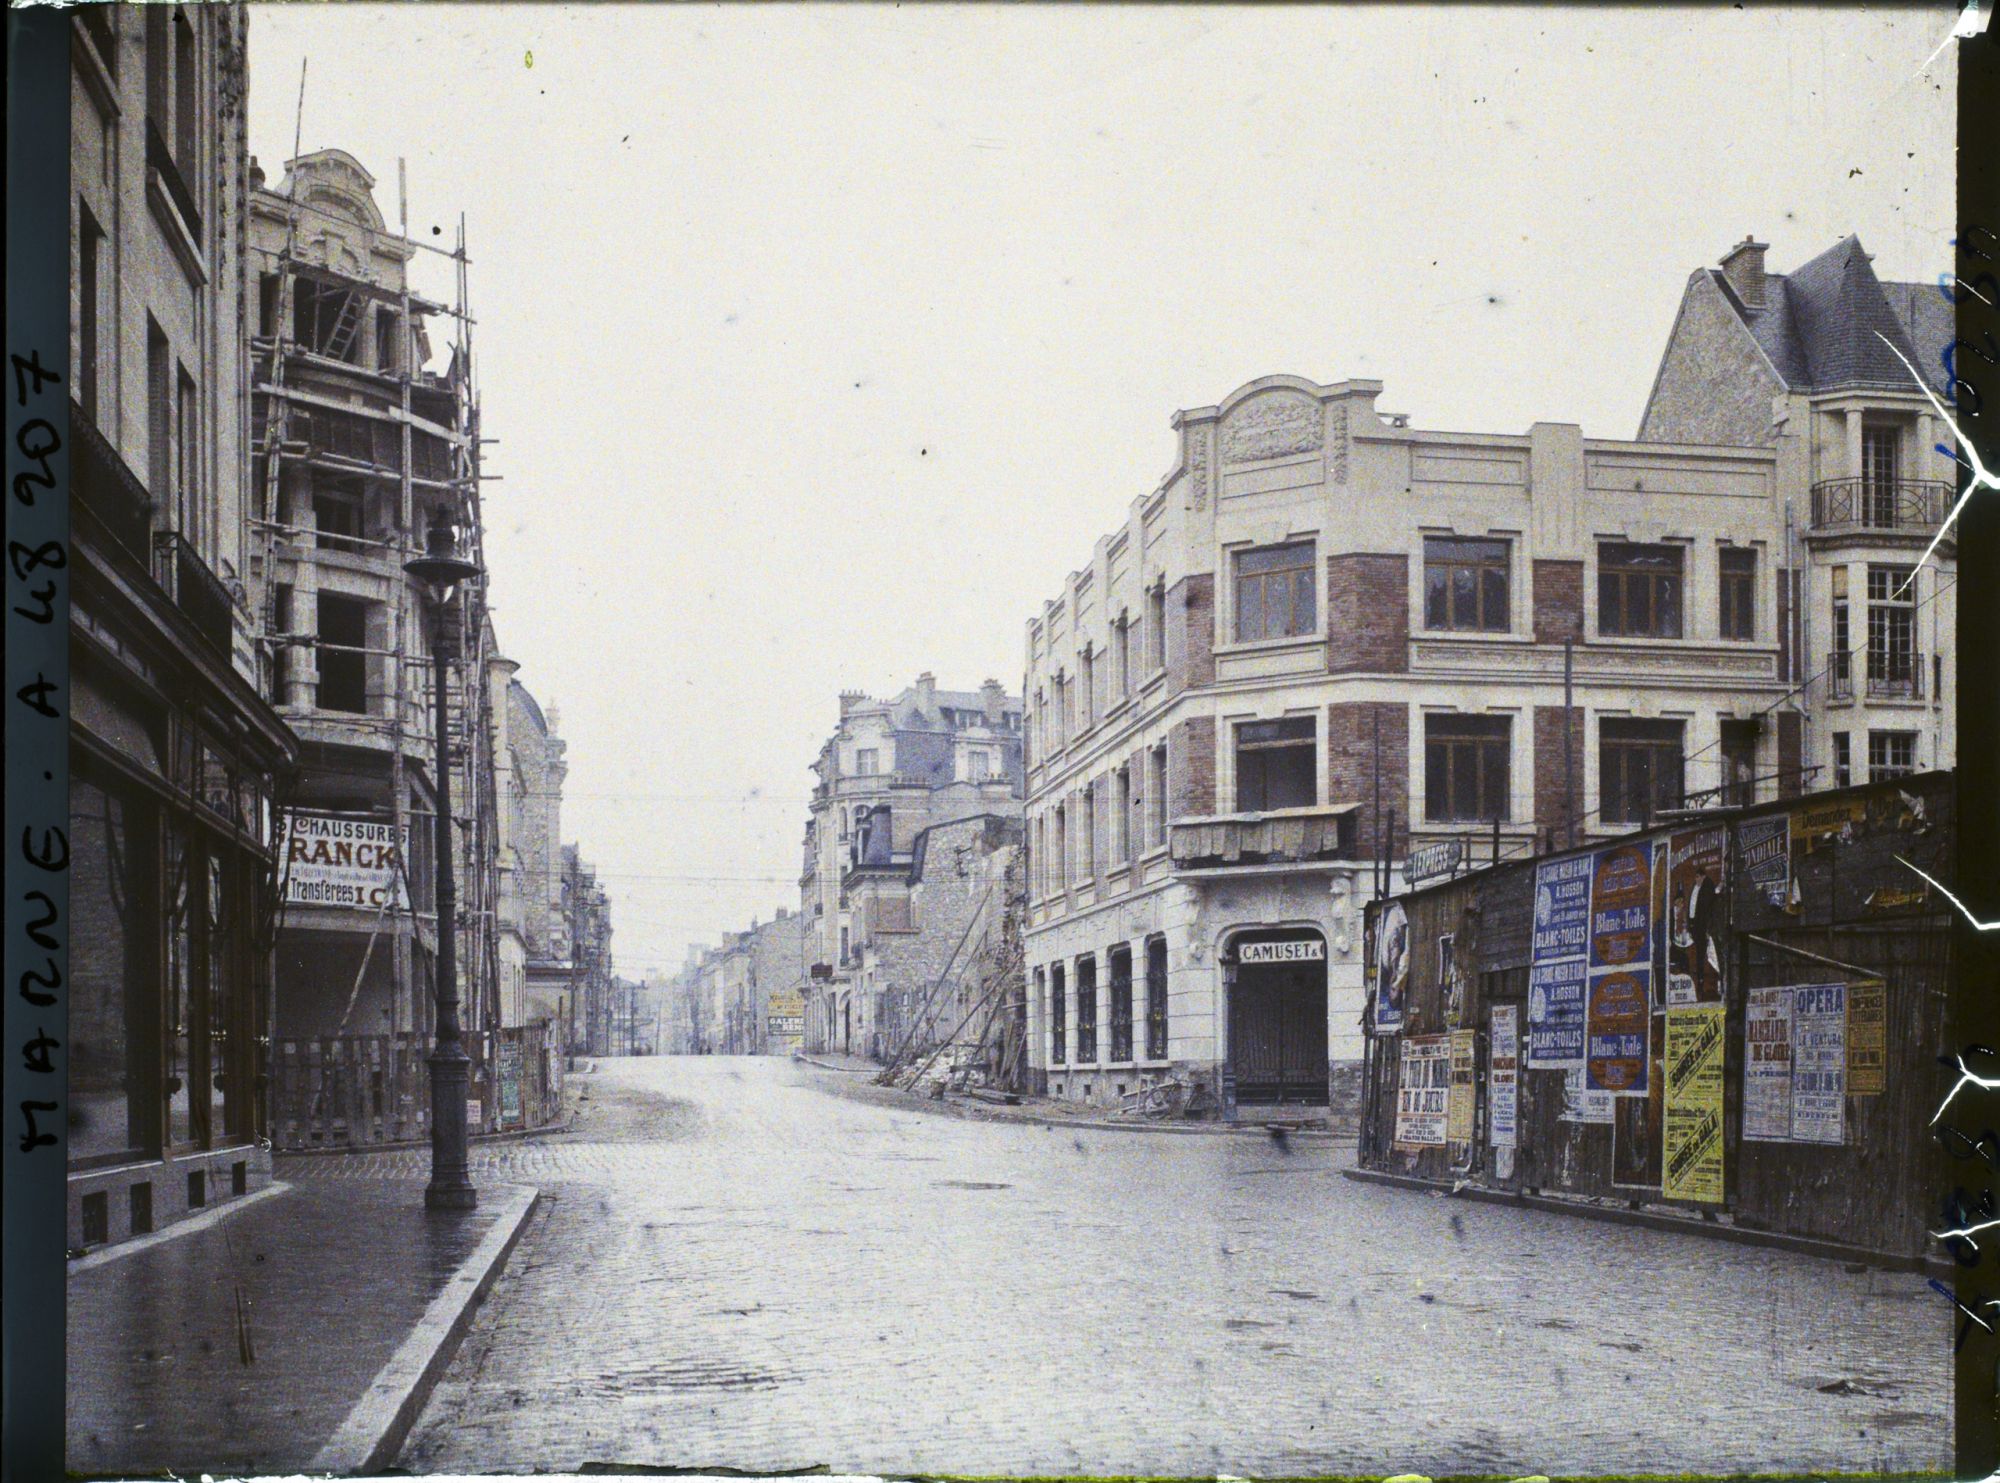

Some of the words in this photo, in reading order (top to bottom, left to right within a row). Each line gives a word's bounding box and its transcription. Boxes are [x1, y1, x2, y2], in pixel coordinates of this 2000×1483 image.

[16, 672, 58, 718] A
[281, 834, 396, 870] RANCK
[1243, 943, 1311, 960] CAMUSET
[1797, 988, 1844, 1014] OPERA
